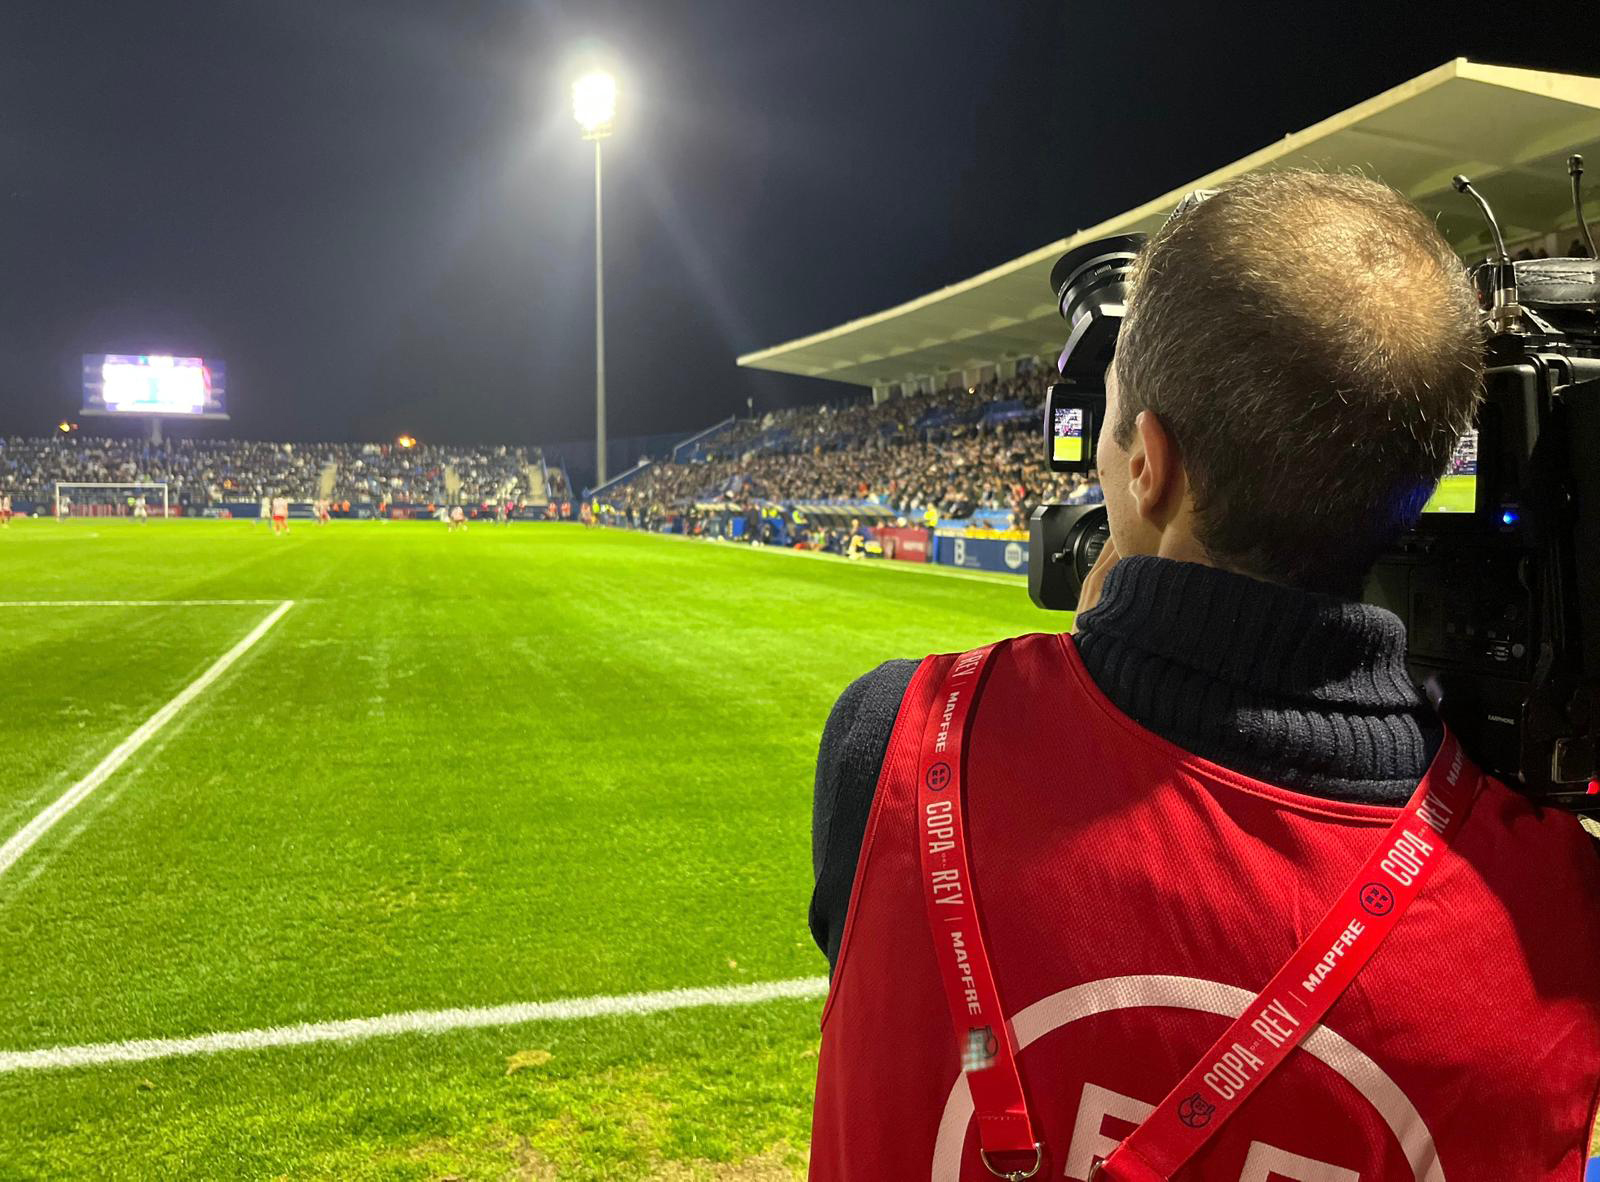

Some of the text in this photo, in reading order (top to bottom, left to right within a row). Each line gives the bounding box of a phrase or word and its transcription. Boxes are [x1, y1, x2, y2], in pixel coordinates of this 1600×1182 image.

[935, 691, 960, 753] MAPFRE
[925, 800, 956, 855] COPA
[1380, 828, 1434, 887] COPA
[1415, 790, 1454, 834] REY
[931, 868, 965, 905] REY
[950, 931, 982, 1016] MAPFRE
[1302, 917, 1366, 992] MAPFRE
[1203, 1041, 1266, 1101] COPA
[1251, 998, 1301, 1048] REY
